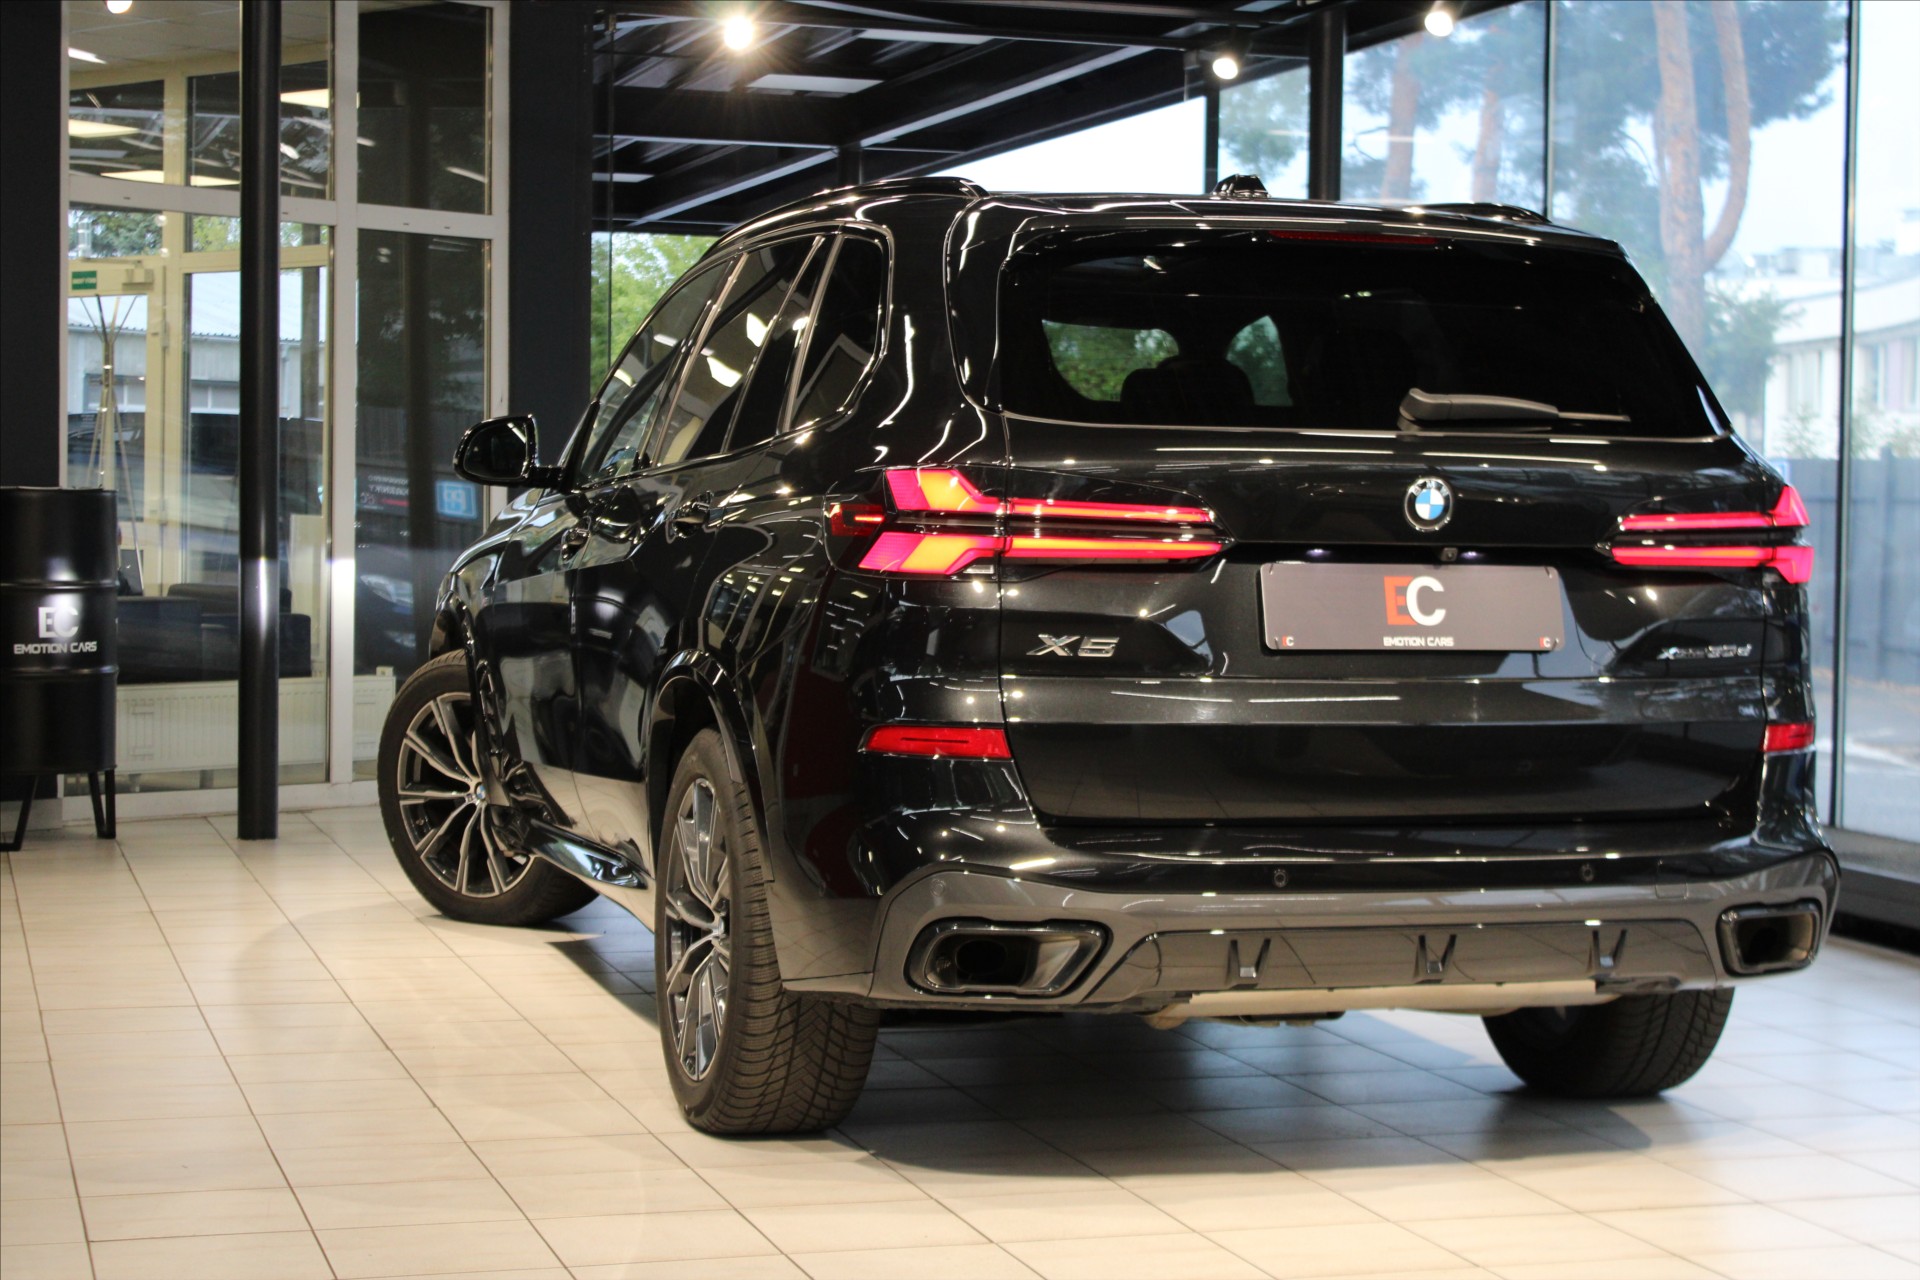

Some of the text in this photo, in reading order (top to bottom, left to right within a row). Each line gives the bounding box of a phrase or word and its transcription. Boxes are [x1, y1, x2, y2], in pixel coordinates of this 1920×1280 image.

[1383, 575, 1446, 626] EC
[38, 607, 79, 638] EC
[14, 642, 97, 654] EMOTION CARS
[1026, 634, 1120, 657] X5
[1383, 636, 1454, 647] EMOTION CARS
